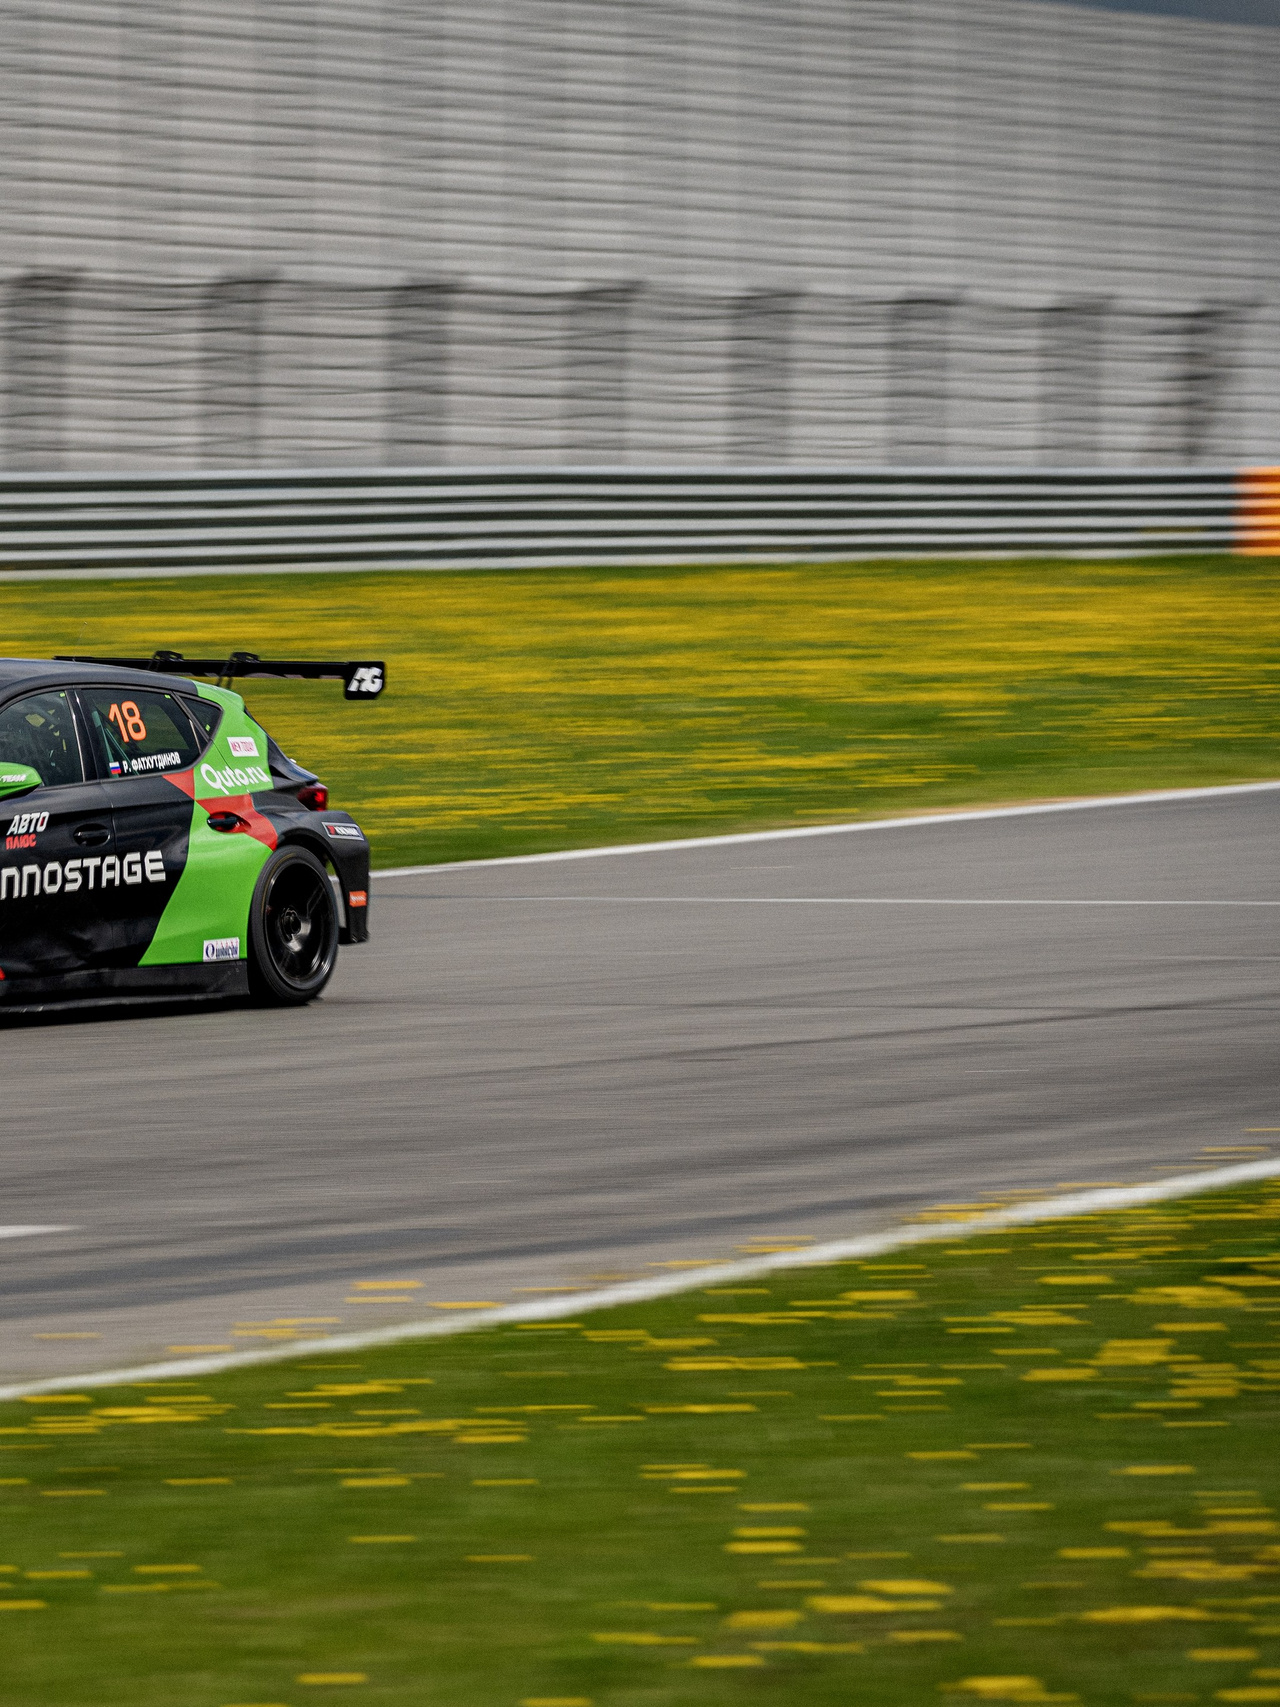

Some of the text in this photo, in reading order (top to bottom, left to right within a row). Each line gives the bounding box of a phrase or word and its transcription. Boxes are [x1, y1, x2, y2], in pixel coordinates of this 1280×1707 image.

[108, 700, 147, 743] 18
[122, 751, 182, 774] Р. ФАТХУТДИНОВ
[200, 762, 271, 796] Quto.ru
[6, 811, 50, 836] АВТО
[5, 833, 37, 850] ПЛЮС
